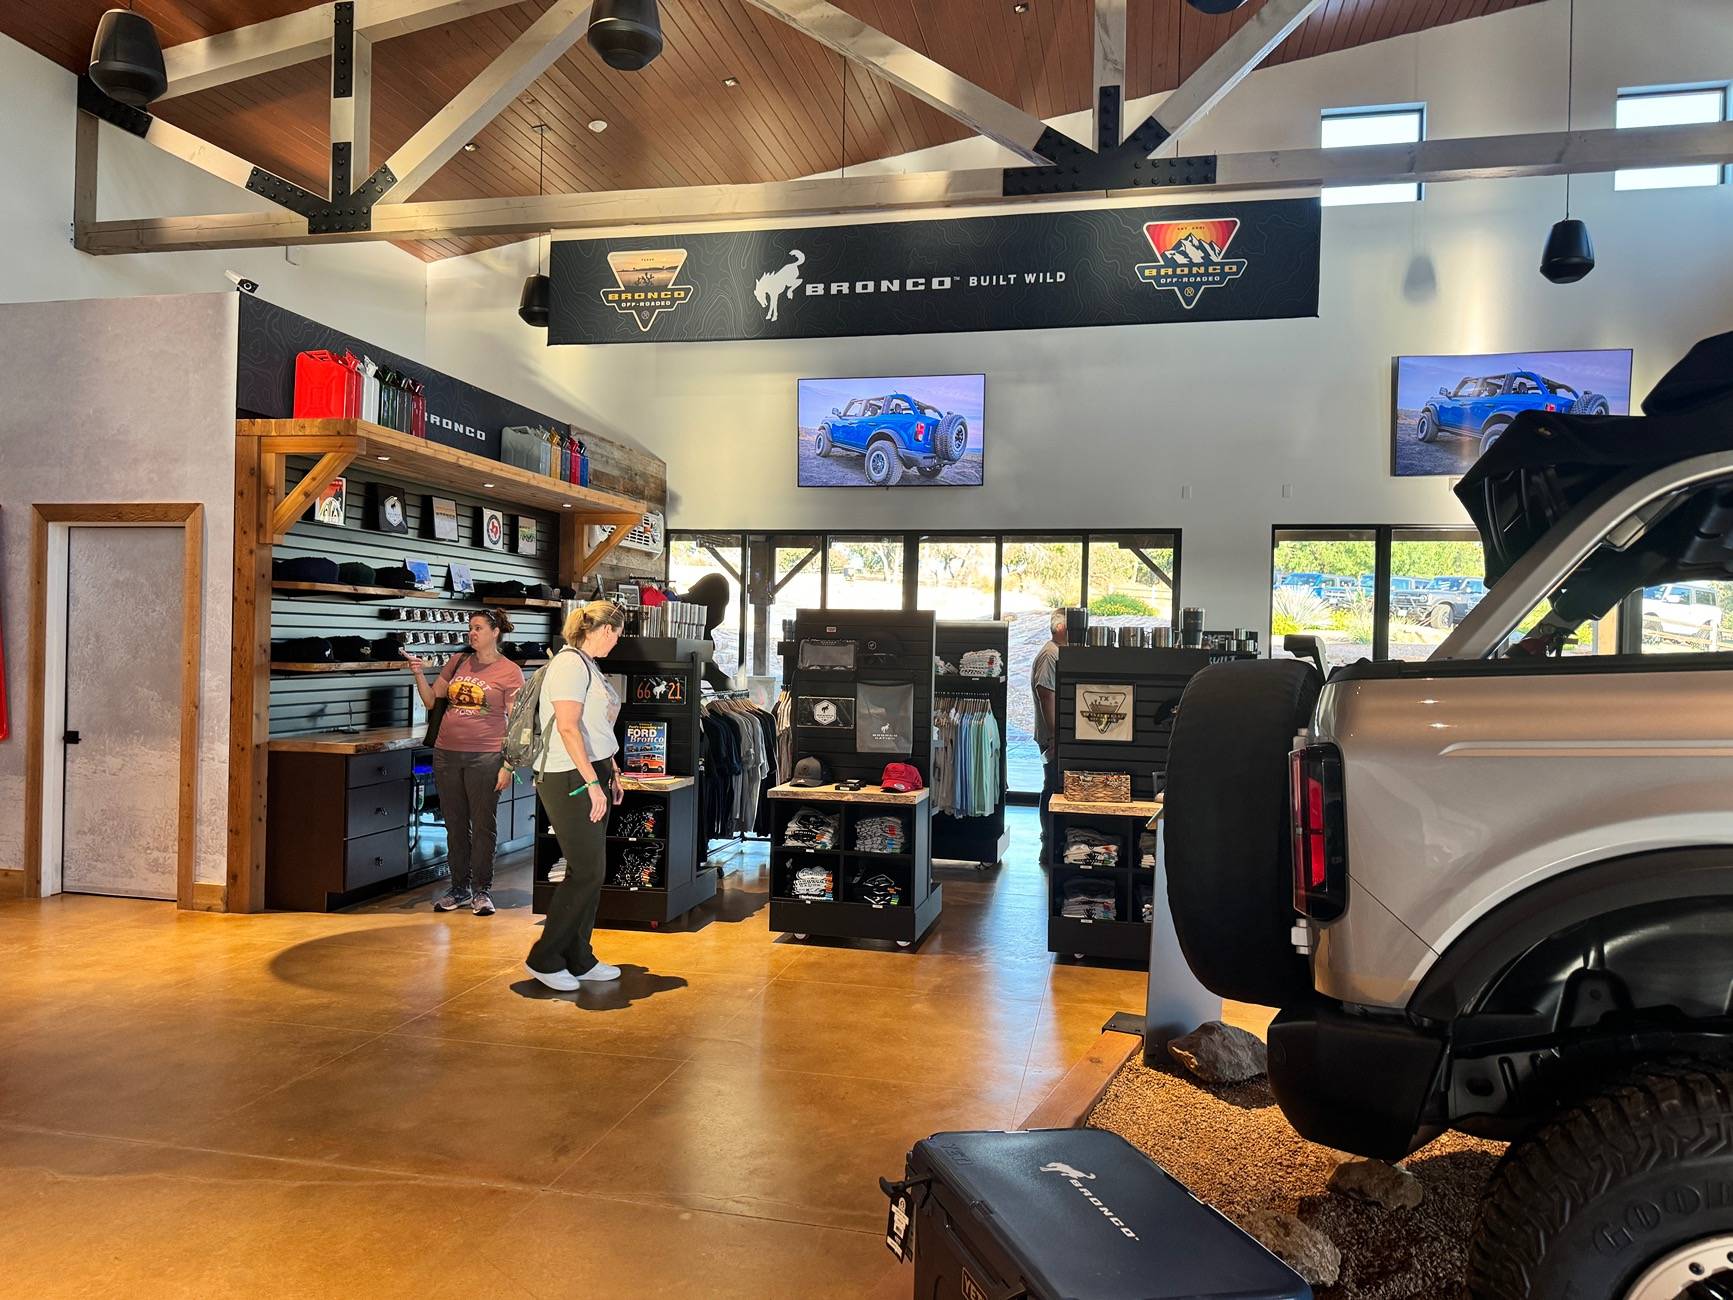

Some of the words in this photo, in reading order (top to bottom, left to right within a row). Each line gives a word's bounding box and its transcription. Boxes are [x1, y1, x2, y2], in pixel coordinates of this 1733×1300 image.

[1144, 265, 1238, 276] BRONCO
[968, 274, 1017, 287] BUILT
[1024, 271, 1067, 284] WILD
[607, 290, 685, 301] BRONCO
[636, 681, 651, 699] 66
[667, 682, 682, 700] 21
[627, 728, 657, 738] FORD
